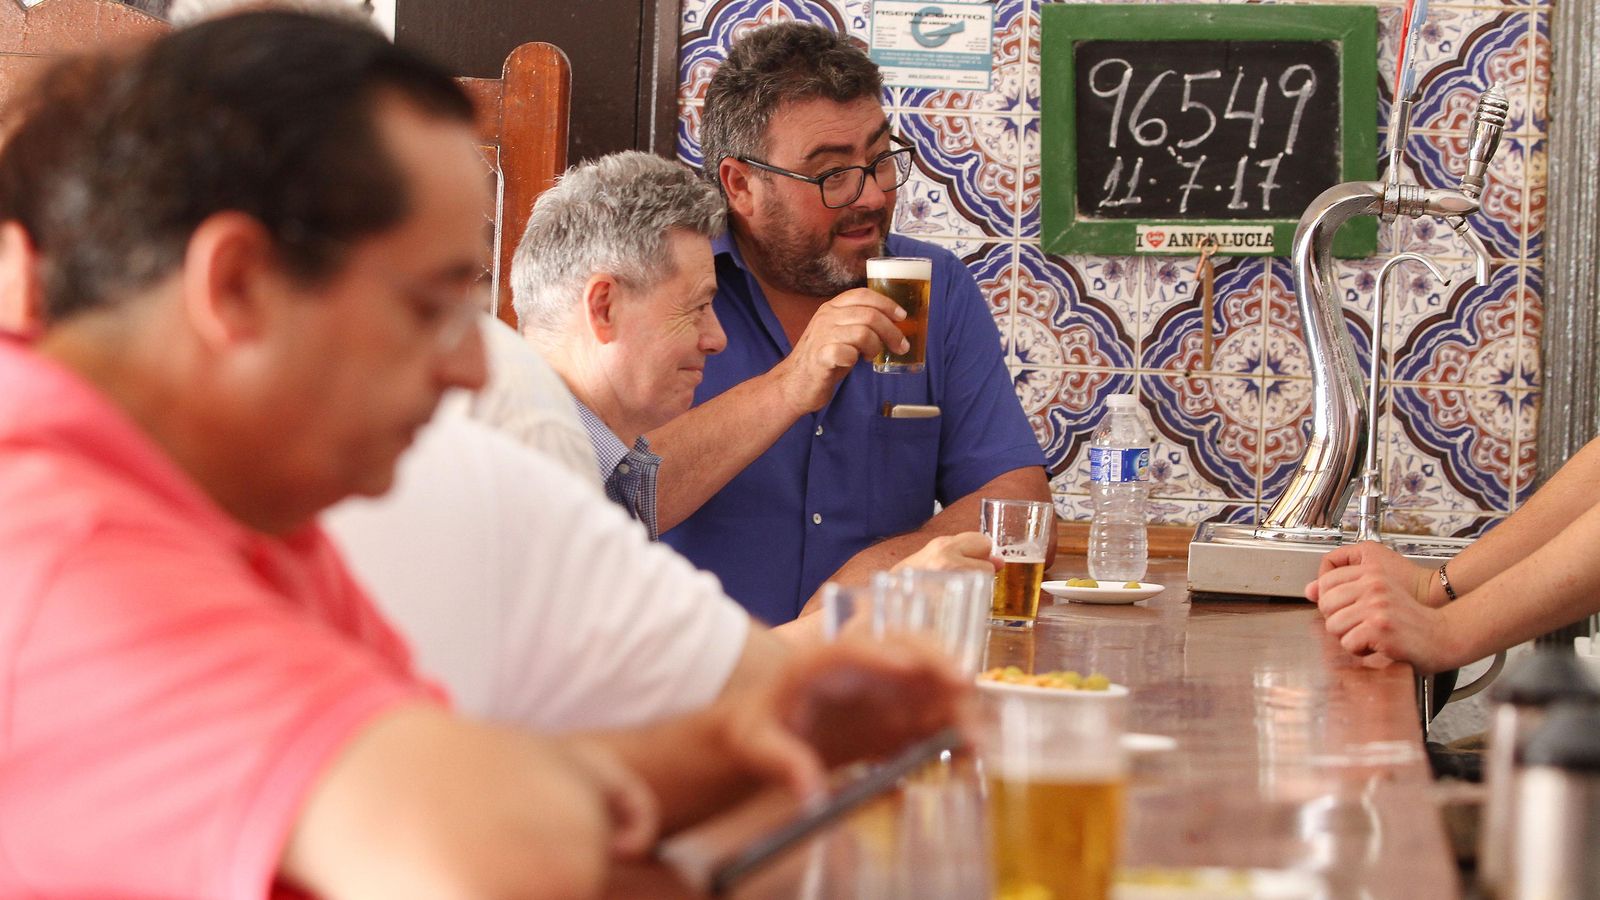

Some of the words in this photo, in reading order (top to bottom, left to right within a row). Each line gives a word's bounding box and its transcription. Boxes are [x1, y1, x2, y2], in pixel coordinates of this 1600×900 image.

[1088, 57, 1318, 155] 96549
[1136, 233, 1143, 247] I
[1167, 232, 1274, 247] ANDALUCIA
